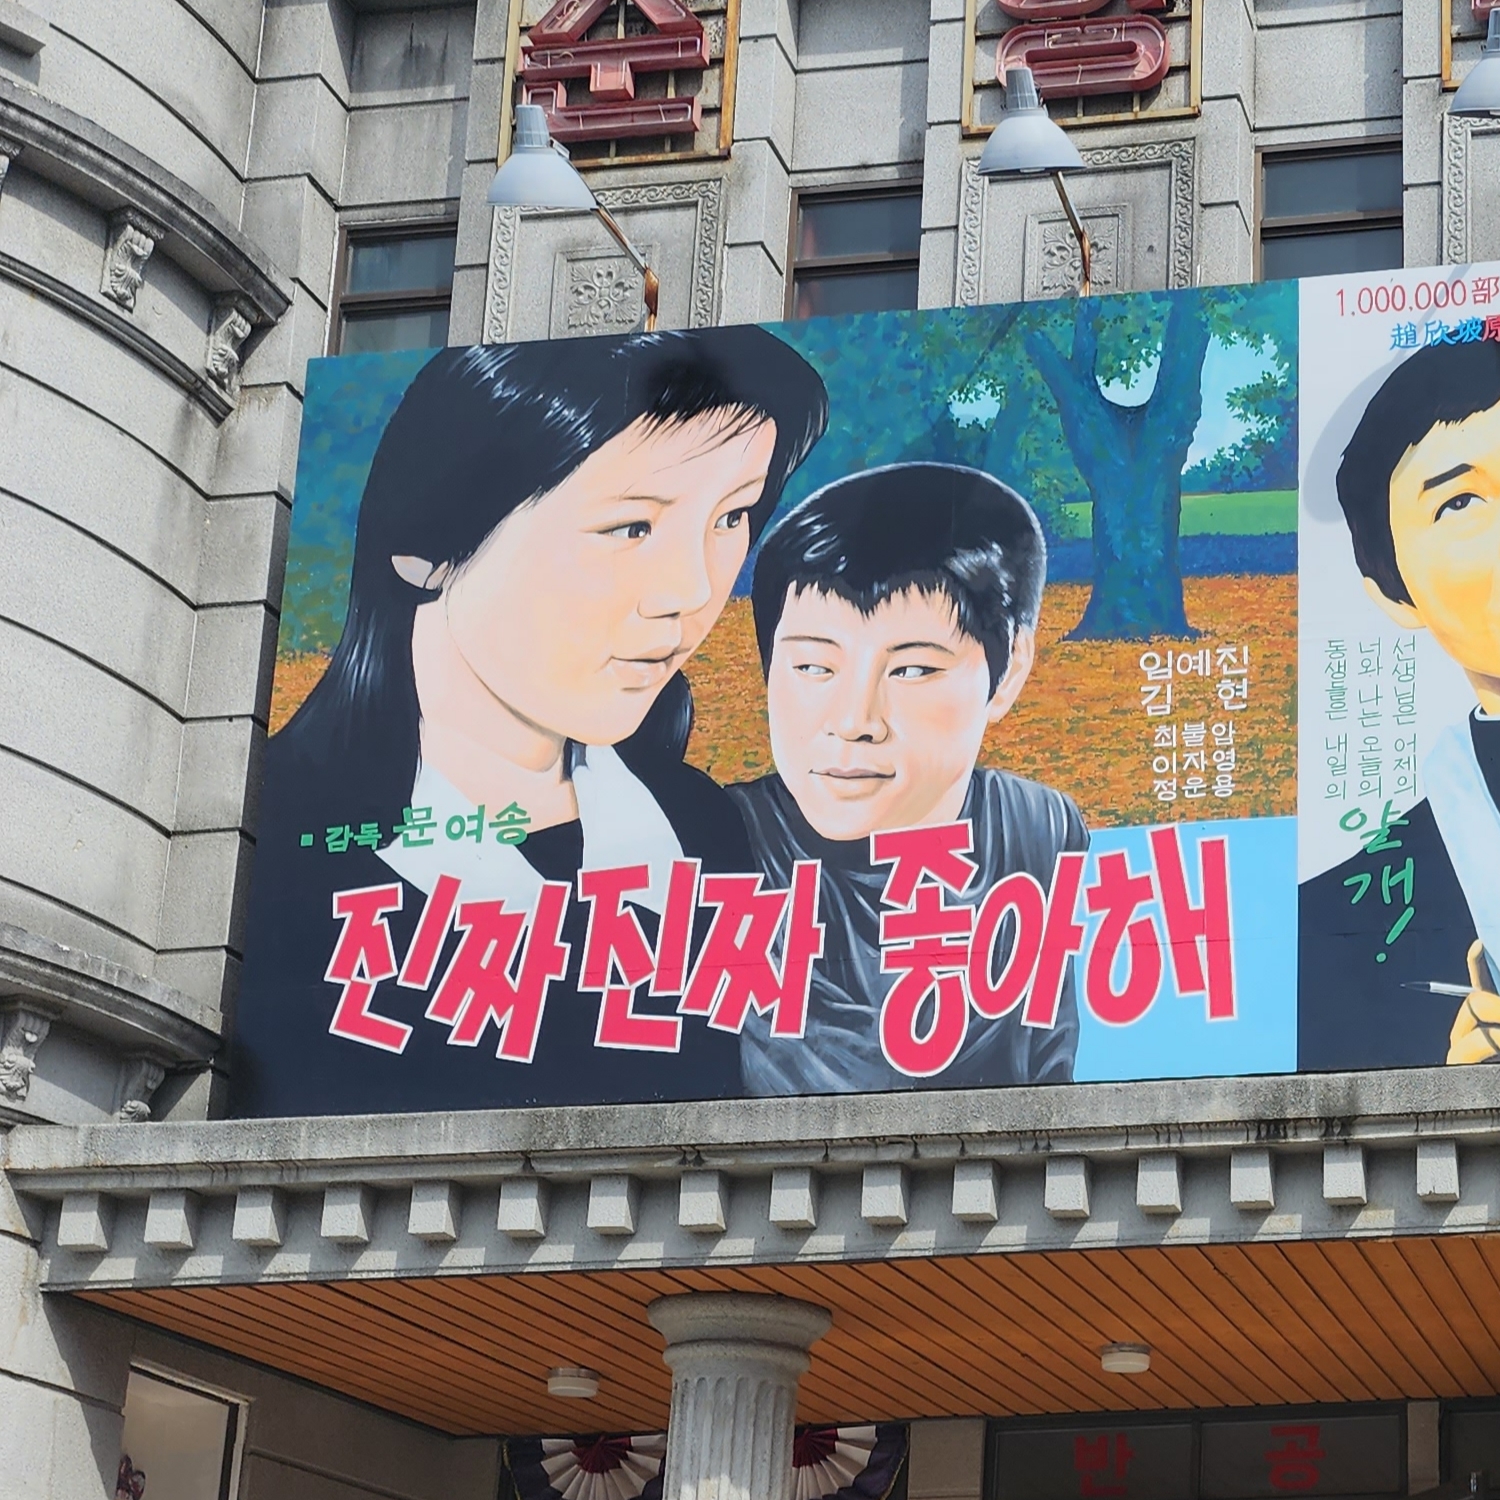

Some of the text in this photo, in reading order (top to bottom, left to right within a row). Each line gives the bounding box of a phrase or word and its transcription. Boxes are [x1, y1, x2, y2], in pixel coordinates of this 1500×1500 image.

[1139, 644, 1249, 682] 임예진
[1153, 719, 1237, 749] 최불암
[1323, 638, 1349, 800] 동생들은 내일의
[1357, 636, 1384, 799] 너와 나는 오늘의
[1392, 635, 1419, 798] 선생님은 어제의
[1152, 749, 1237, 775] 이자영
[1152, 775, 1237, 801] 정운용
[324, 801, 532, 853] 감독 문여송
[323, 818, 1238, 1078] 진짜 진짜 좋아해
